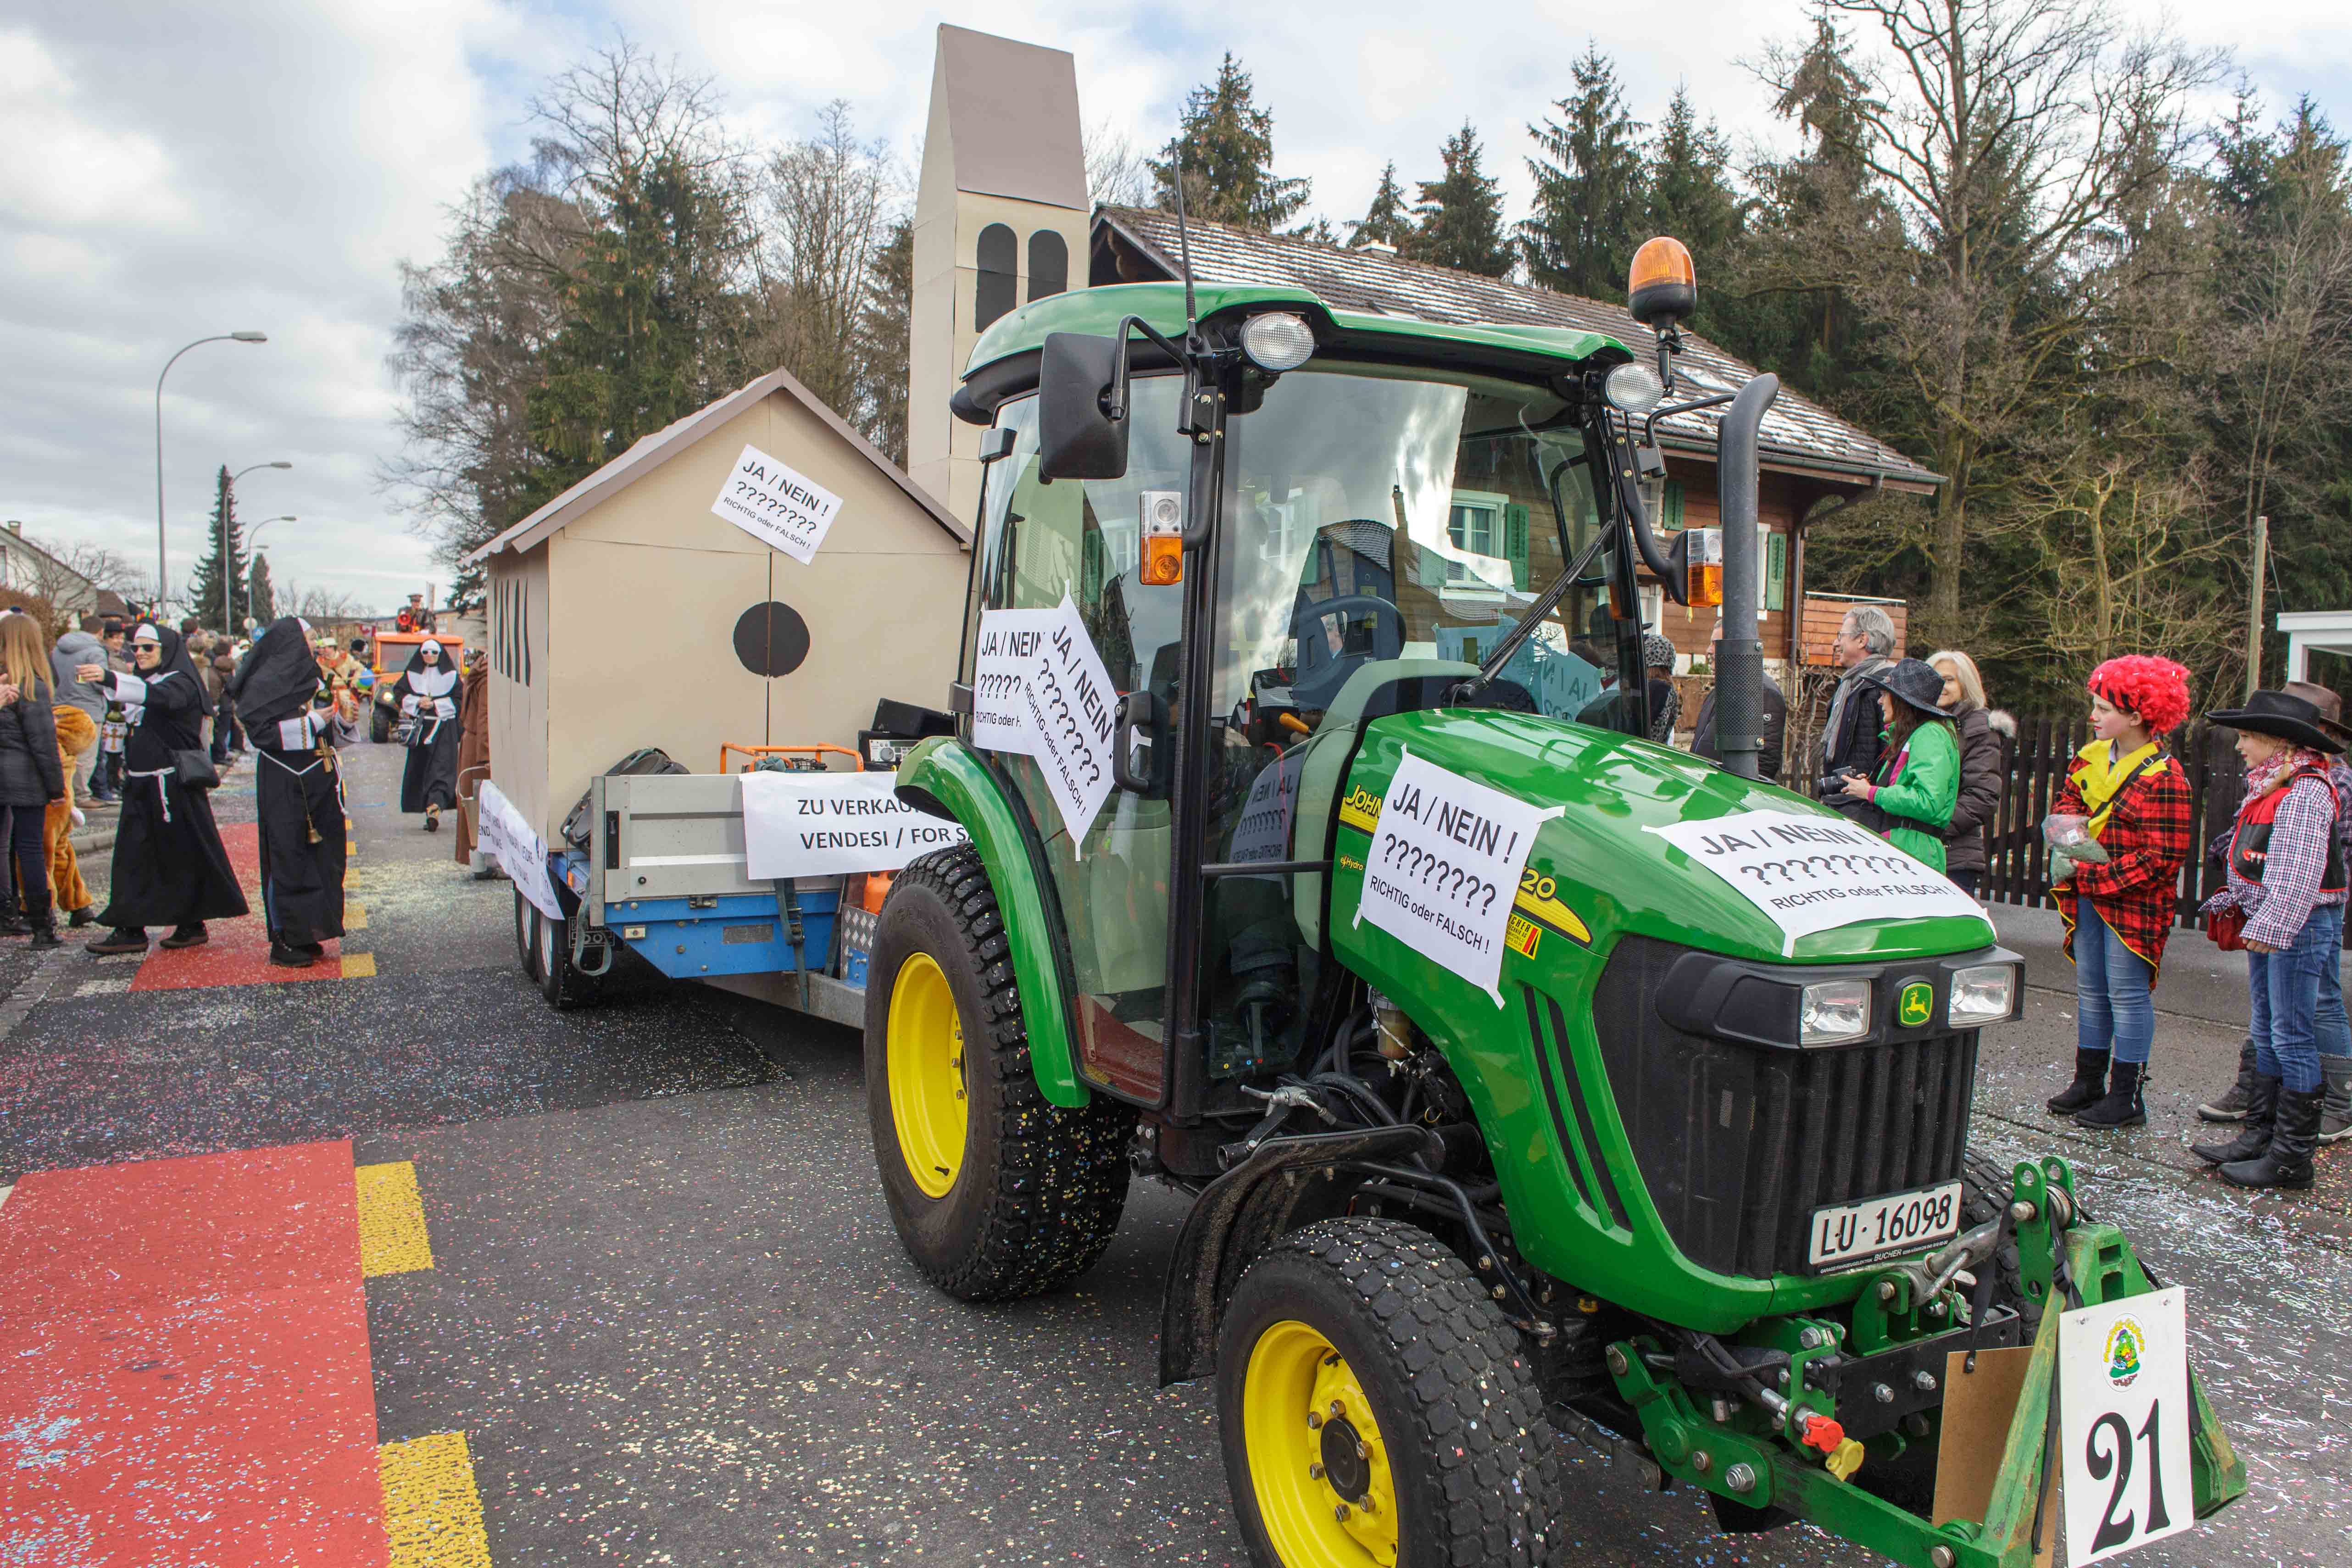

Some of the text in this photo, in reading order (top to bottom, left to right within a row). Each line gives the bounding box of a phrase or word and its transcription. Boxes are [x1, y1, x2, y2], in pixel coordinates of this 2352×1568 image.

[743, 461, 765, 481] JA
[768, 474, 778, 485] /
[778, 479, 820, 511] NEIN
[723, 497, 756, 519] RICHTIG
[757, 517, 775, 528] oder
[775, 526, 806, 547] FALSCH
[982, 631, 997, 657] JA
[1000, 631, 1006, 656] /
[1053, 625, 1072, 665] JA
[1074, 670, 1113, 745] NEIN
[976, 711, 997, 725] RICHTIG
[998, 712, 1015, 727] oder
[1024, 682, 1045, 730] RICHTIG
[1045, 732, 1059, 756] oder
[1057, 756, 1084, 810] FALSCH
[797, 799, 824, 815] ZU
[1393, 783, 1518, 864] JA / NEIN !
[800, 831, 888, 849] VENDESI
[895, 827, 903, 848] /
[911, 828, 951, 844] FOR
[1700, 832, 1756, 855] JA
[1767, 824, 1863, 845] NEIN
[1385, 833, 1496, 917] ????????
[1520, 866, 1556, 900] 20
[1769, 888, 1846, 909] RICHTIG
[1848, 885, 1884, 898] oder
[1883, 884, 1950, 896] FALSCH
[1370, 875, 1409, 908] RICHTIG
[1411, 900, 1435, 921] oder
[1435, 913, 1482, 951] FALSCH
[1820, 1212, 1857, 1256] LU
[1875, 1193, 1952, 1245] 16098
[1874, 1248, 1902, 1262] BUCHER
[2086, 1398, 2171, 1555] 21
